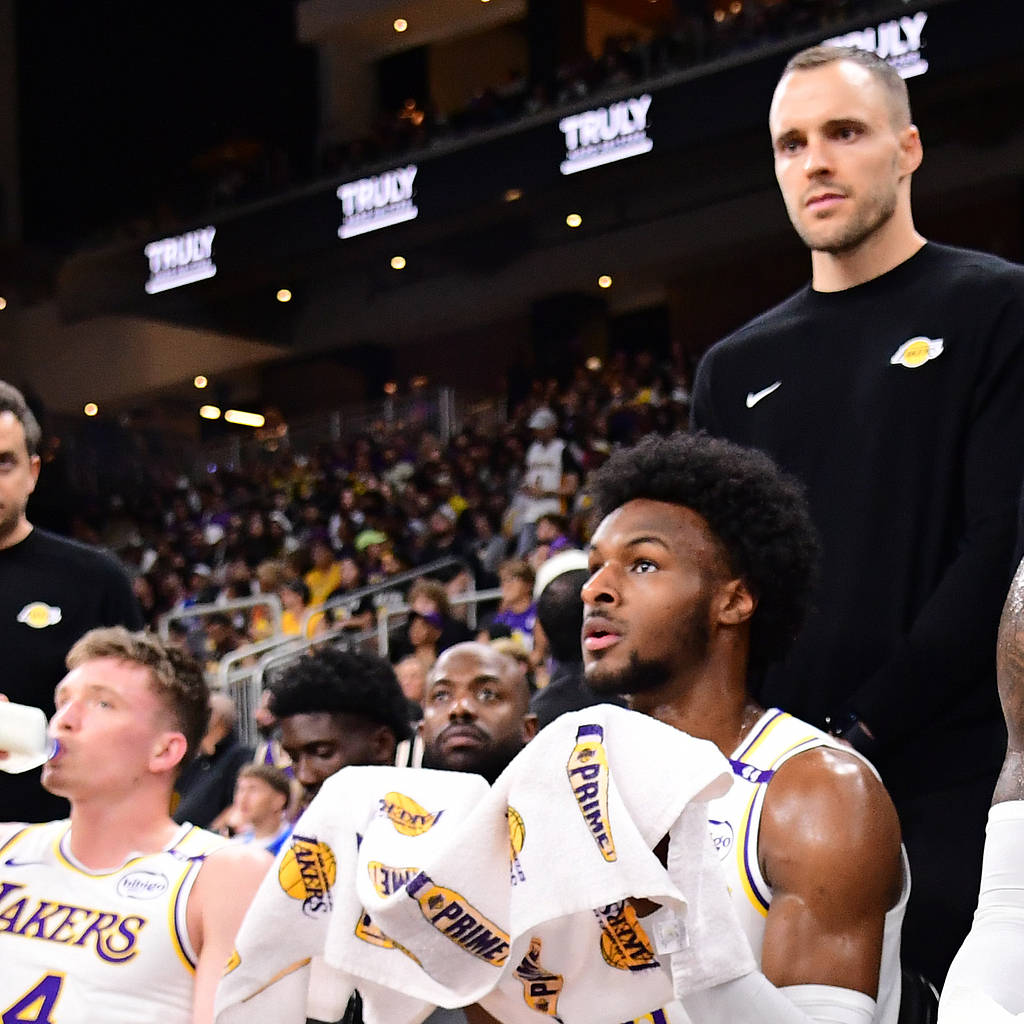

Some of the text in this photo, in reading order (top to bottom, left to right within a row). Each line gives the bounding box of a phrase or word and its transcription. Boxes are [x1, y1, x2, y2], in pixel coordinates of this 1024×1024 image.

[820, 11, 928, 59] ULY
[559, 94, 652, 151] TRULY
[336, 164, 417, 216] TRULY
[144, 226, 216, 273] TRULY
[569, 764, 610, 849] PRIME
[432, 901, 510, 961] PRIME
